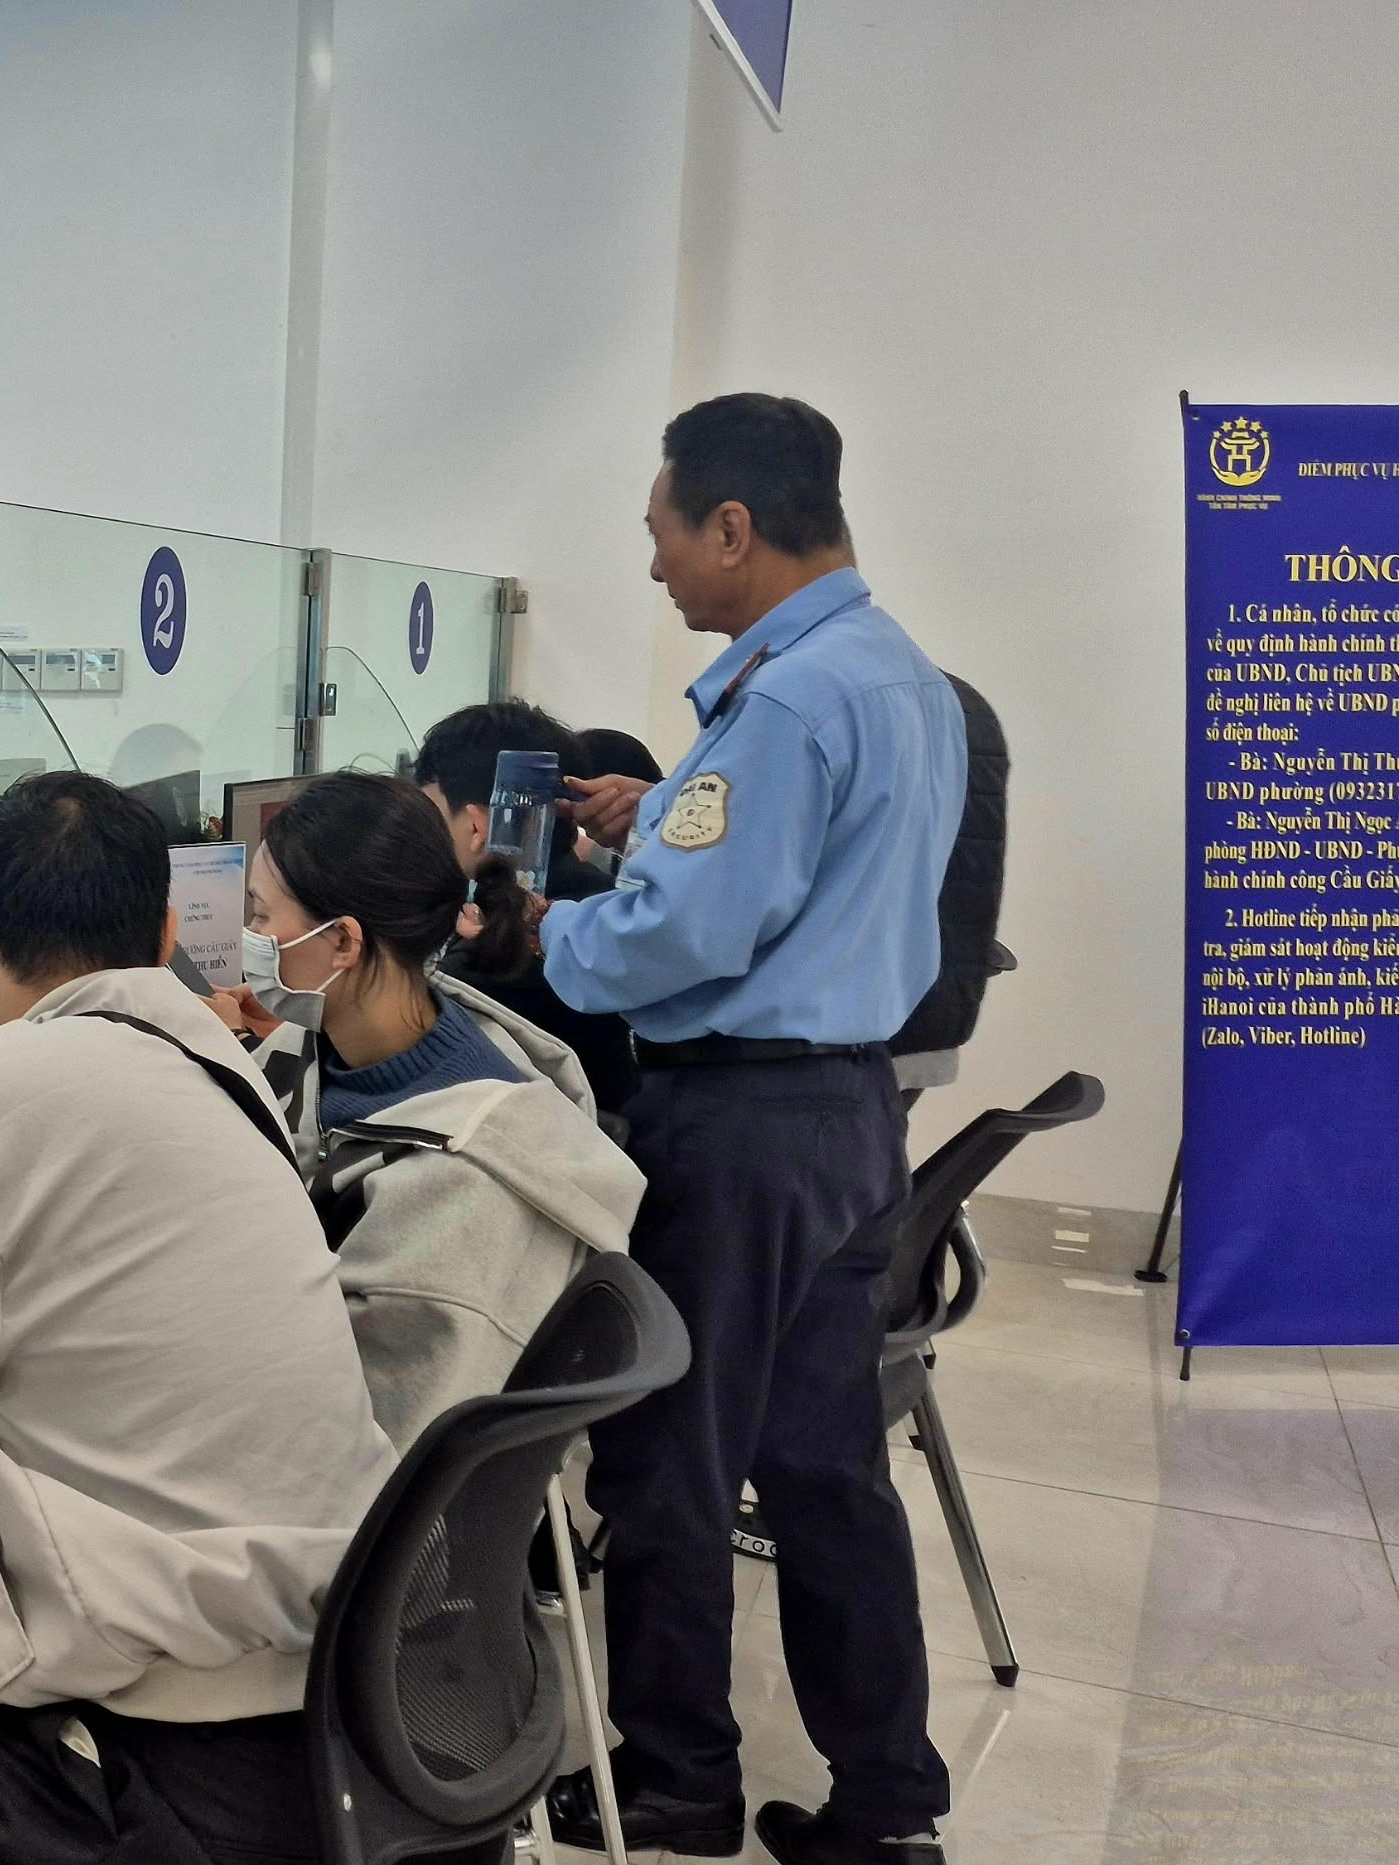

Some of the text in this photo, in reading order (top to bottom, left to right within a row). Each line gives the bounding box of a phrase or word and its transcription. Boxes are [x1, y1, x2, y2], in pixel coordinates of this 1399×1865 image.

[1335, 462, 1370, 480] PHỤC
[1372, 462, 1390, 480] VỤ
[1285, 545, 1399, 582] THÔNG
[153, 573, 175, 649] 2
[1229, 603, 1242, 623] 1.
[1245, 603, 1268, 623] Cá
[1272, 603, 1317, 625] nhân,
[1322, 598, 1338, 623] tổ
[1341, 603, 1379, 623] chức
[416, 602, 425, 654] 1
[1207, 628, 1386, 657] về quy định hành chính
[1206, 663, 1232, 682] của
[1236, 663, 1291, 686] UBND,
[1295, 663, 1329, 682] Chủ
[1333, 663, 1363, 687] tịch
[1206, 687, 1389, 717] đề nghị liên hệ về UBND
[1205, 717, 1299, 747] số điện thoại:
[1240, 752, 1268, 771] Bà:
[1273, 747, 1336, 776] Nguyễn
[1339, 752, 1369, 776] Thị
[1205, 781, 1255, 800] UBND
[1259, 781, 1325, 806] phường
[1235, 811, 1261, 830] Bà:
[1265, 806, 1322, 835] Nguyễn
[1325, 811, 1351, 835] Thị
[1355, 811, 1392, 835] Ngọc
[1204, 840, 1247, 865] phòng
[1251, 840, 1301, 860] HĐND
[1314, 840, 1363, 860] UBND
[1204, 869, 1239, 889] hành
[1242, 869, 1286, 889] chính
[1289, 869, 1327, 894] công
[1330, 865, 1362, 889] Cầu
[1224, 908, 1239, 927] 2.
[1241, 908, 1296, 927] Hotline
[1299, 903, 1327, 932] tiếp
[1331, 908, 1368, 933] nhận
[1203, 940, 1227, 959] tra,
[1230, 938, 1266, 961] giám
[1270, 938, 1292, 957] sát
[1295, 938, 1328, 961] hoạt
[1332, 937, 1369, 962] động
[1203, 967, 1224, 991] nội
[1227, 967, 1250, 991] bộ,
[1254, 967, 1274, 987] xử
[1277, 967, 1291, 991] lý
[1295, 967, 1334, 991] phản
[1338, 967, 1372, 989] ánh,
[1202, 996, 1254, 1016] iHanoi
[1258, 996, 1286, 1016] của
[1291, 996, 1339, 1016] thành
[1344, 991, 1375, 1020] phố
[1201, 1026, 1367, 1049] (Zalo, Viber, Hotline)
